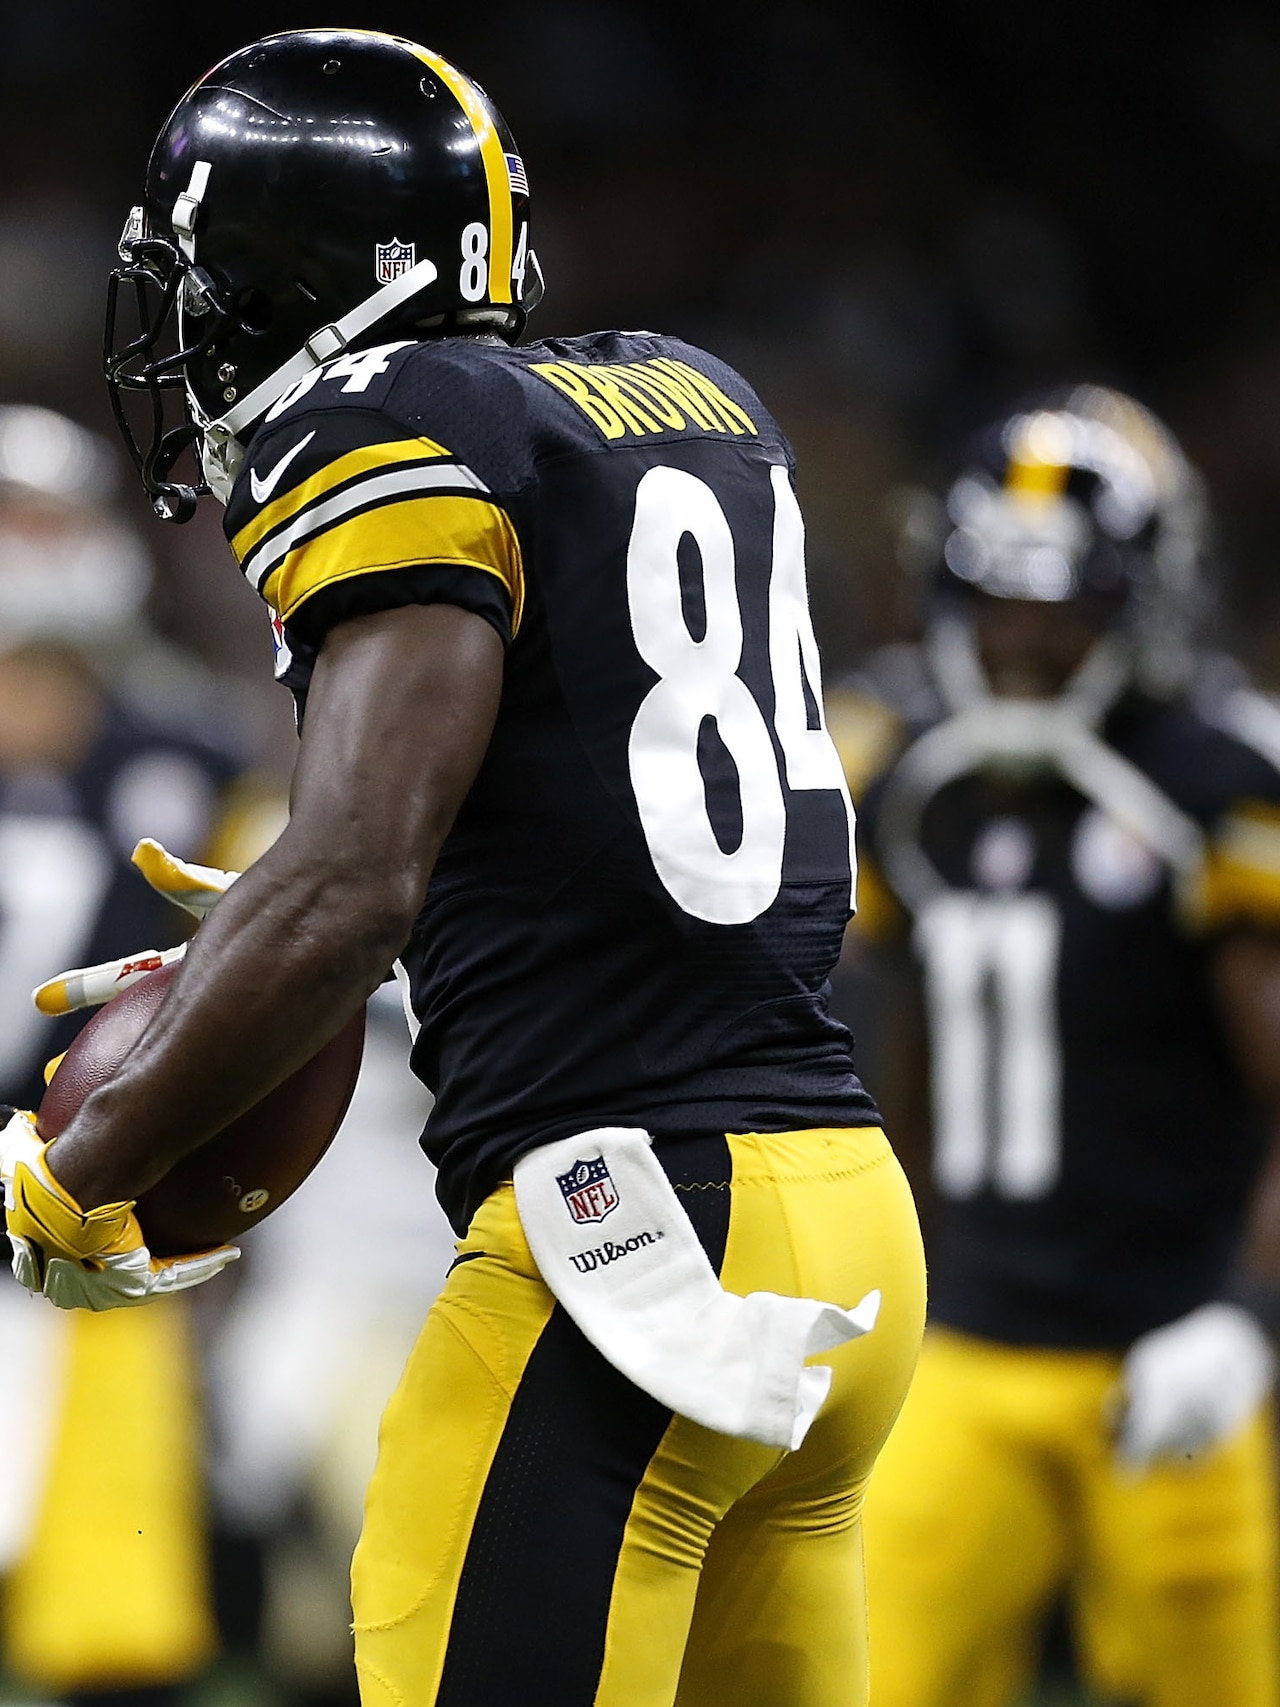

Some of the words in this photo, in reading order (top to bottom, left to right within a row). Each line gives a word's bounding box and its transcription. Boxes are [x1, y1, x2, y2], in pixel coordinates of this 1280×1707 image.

[528, 357, 759, 440] BROWN
[626, 464, 859, 925] 84
[568, 1182, 615, 1220] NFL
[568, 1232, 656, 1273] Wilson
